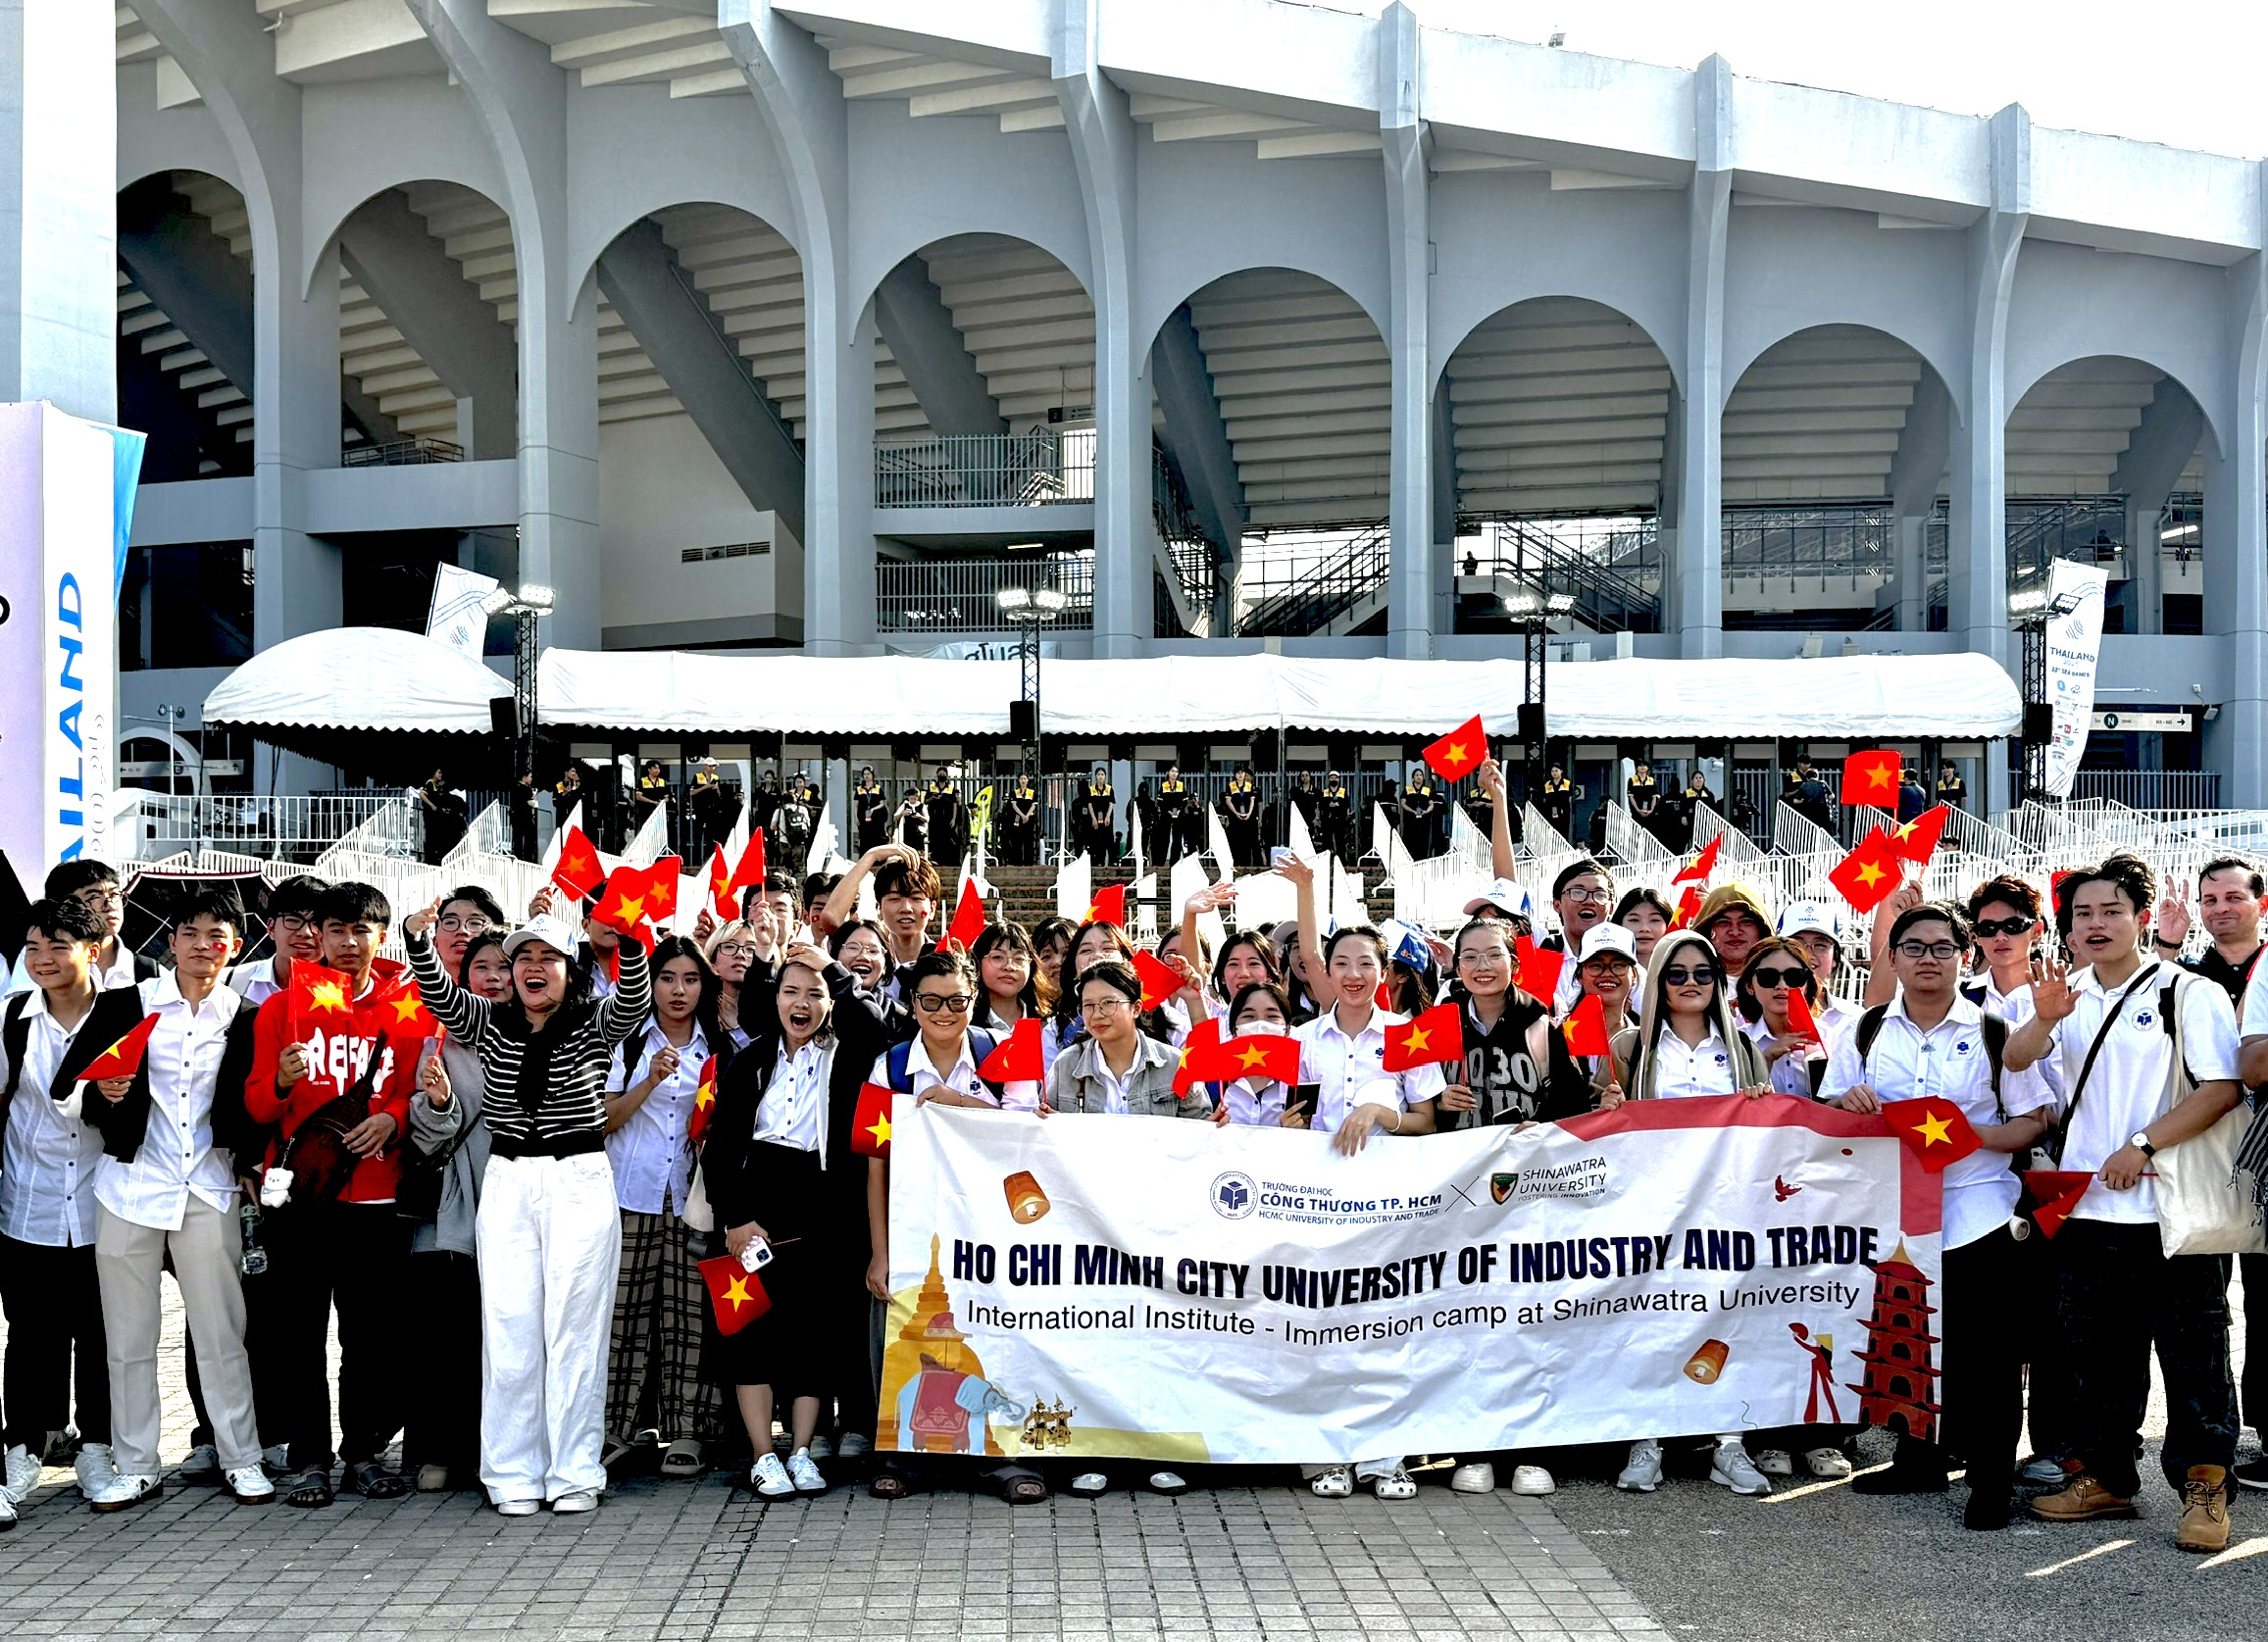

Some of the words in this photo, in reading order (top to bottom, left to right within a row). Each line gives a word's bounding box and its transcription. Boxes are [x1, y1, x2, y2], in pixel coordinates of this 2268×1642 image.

[2049, 646, 2095, 663] THAILAND
[2107, 717, 2115, 726] N
[1523, 1156, 1607, 1181] SHINAWATRA
[1262, 1181, 1298, 1193] TRƯỜNG
[1299, 1186, 1315, 1197] ĐẠI
[1316, 1188, 1334, 1197] HỌC
[1520, 1172, 1607, 1194] UNIVERSITY
[1260, 1192, 1305, 1210] CÔNG
[1309, 1199, 1377, 1213] THƯƠNG
[1381, 1198, 1404, 1211] TP.
[1408, 1194, 1442, 1209] HCM
[1518, 1193, 1558, 1202] FOSTERING
[1560, 1188, 1606, 1199] INNOVATION
[1258, 1210, 1284, 1220] HCMC
[1285, 1214, 1335, 1225] UNIVERSITY
[1349, 1215, 1393, 1224] INDUSTRY
[1394, 1213, 1413, 1222] AND
[1414, 1208, 1440, 1219] TRADE
[953, 1239, 996, 1284] HO
[1008, 1244, 1062, 1287] CHI
[1074, 1244, 1164, 1290] MINH
[1177, 1258, 1250, 1299] CITY
[1262, 1250, 1447, 1310] UNIVERSITY
[1457, 1243, 1498, 1285] OF
[1510, 1233, 1674, 1283] INDUSTRY
[1683, 1228, 1755, 1271] AND
[1766, 1224, 1879, 1269] TRADE
[967, 1299, 1134, 1330] International
[1145, 1305, 1256, 1335] Institute
[1285, 1314, 1424, 1346] Immersion
[1431, 1306, 1507, 1329] camp
[1517, 1302, 1544, 1324] at
[1553, 1289, 1709, 1321] Shinawatra
[1719, 1280, 1861, 1312] University
